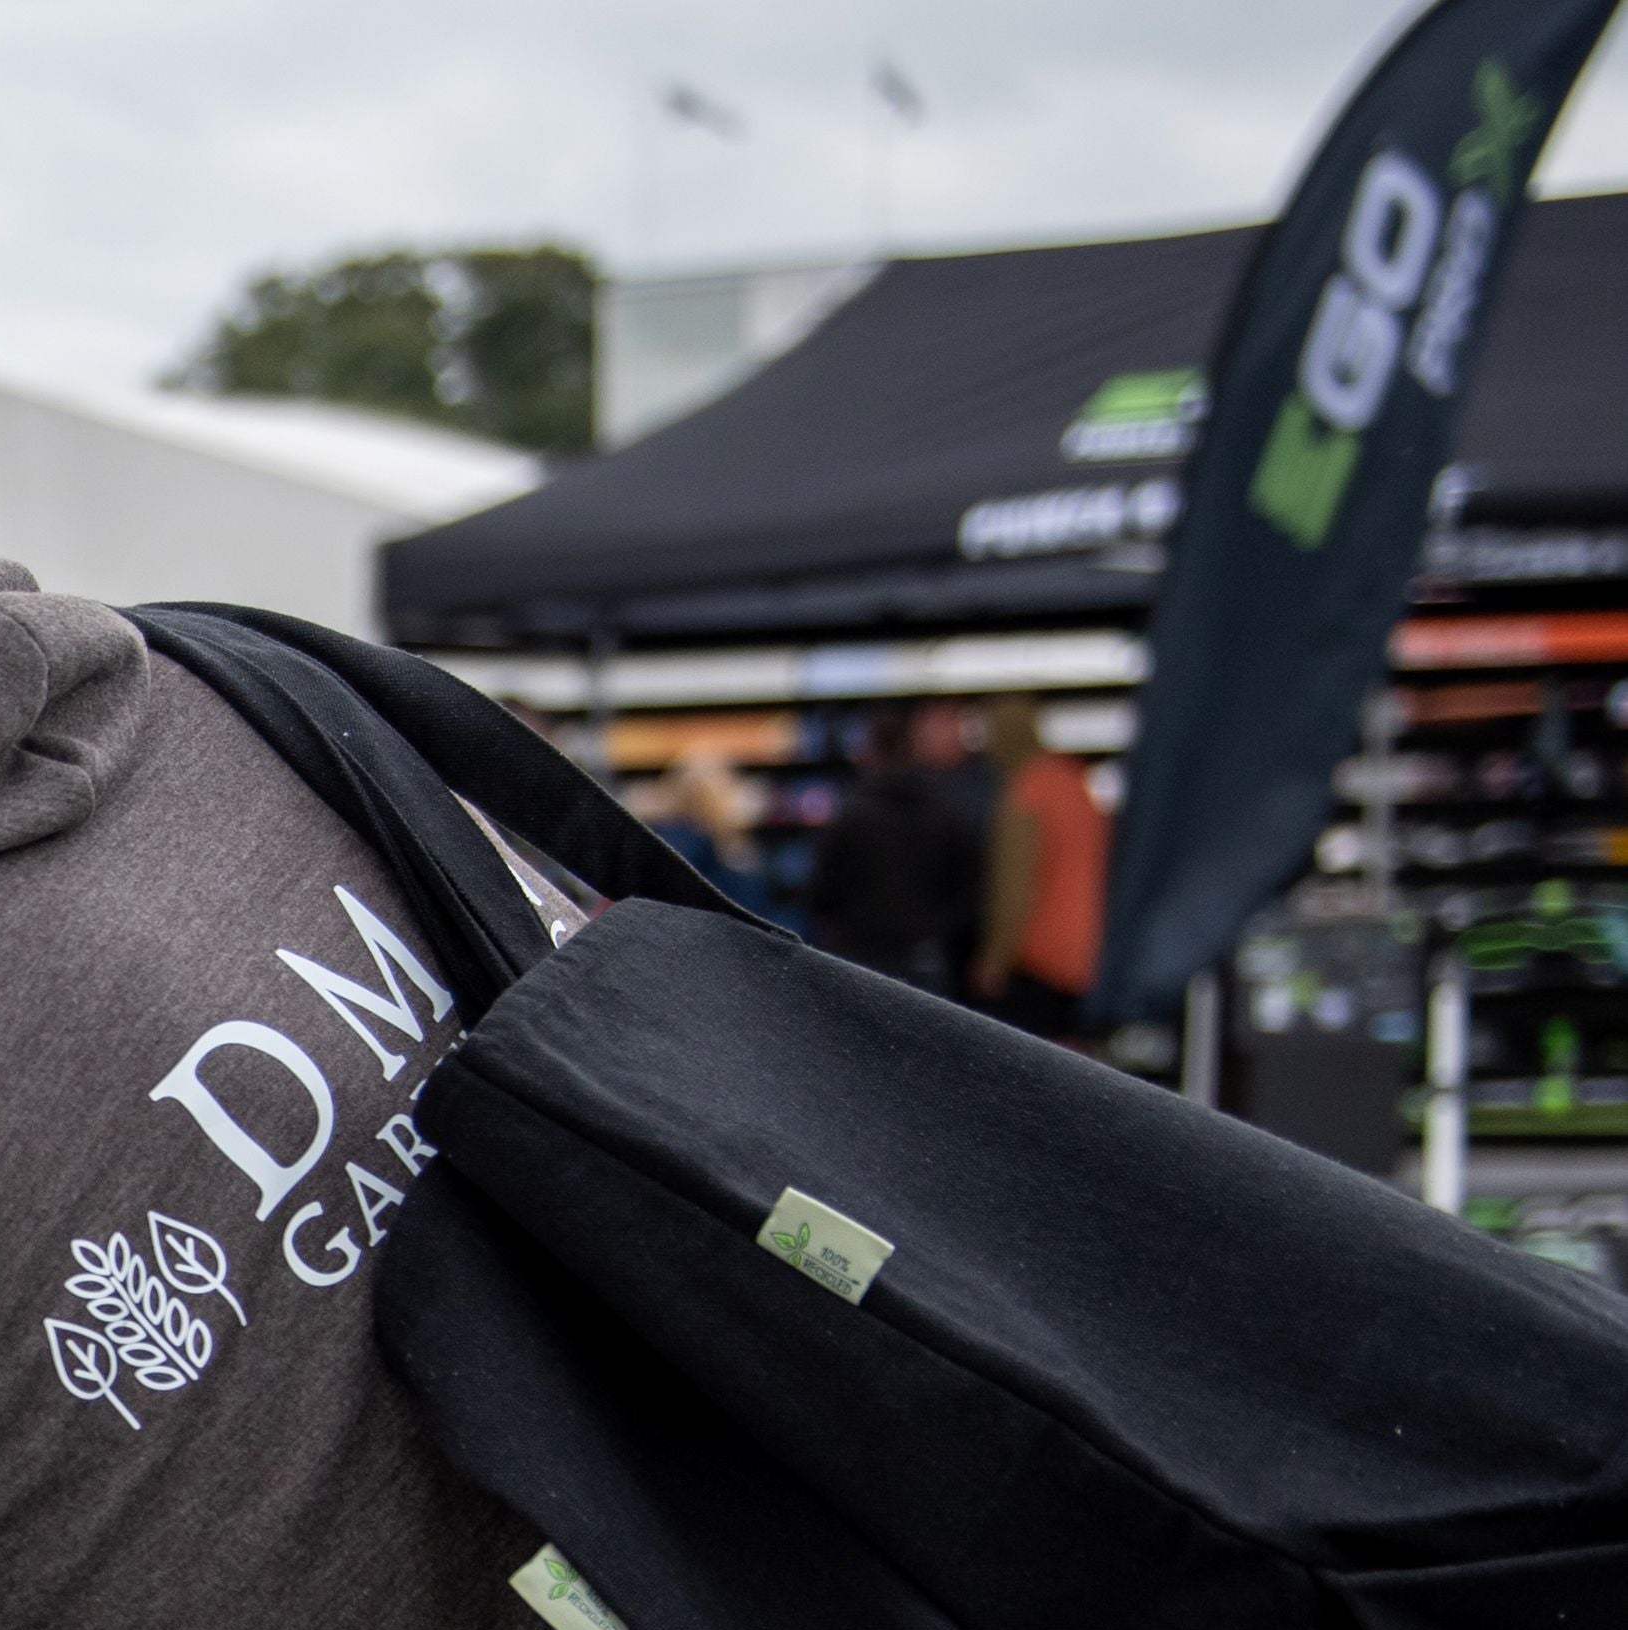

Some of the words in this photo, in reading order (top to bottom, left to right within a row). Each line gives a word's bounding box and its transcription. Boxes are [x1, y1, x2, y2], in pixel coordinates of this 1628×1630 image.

[1248, 148, 1442, 552] EGO
[281, 1030, 468, 1287] GAR
[802, 1258, 853, 1295] RECYCLED
[820, 1247, 851, 1273] 100%
